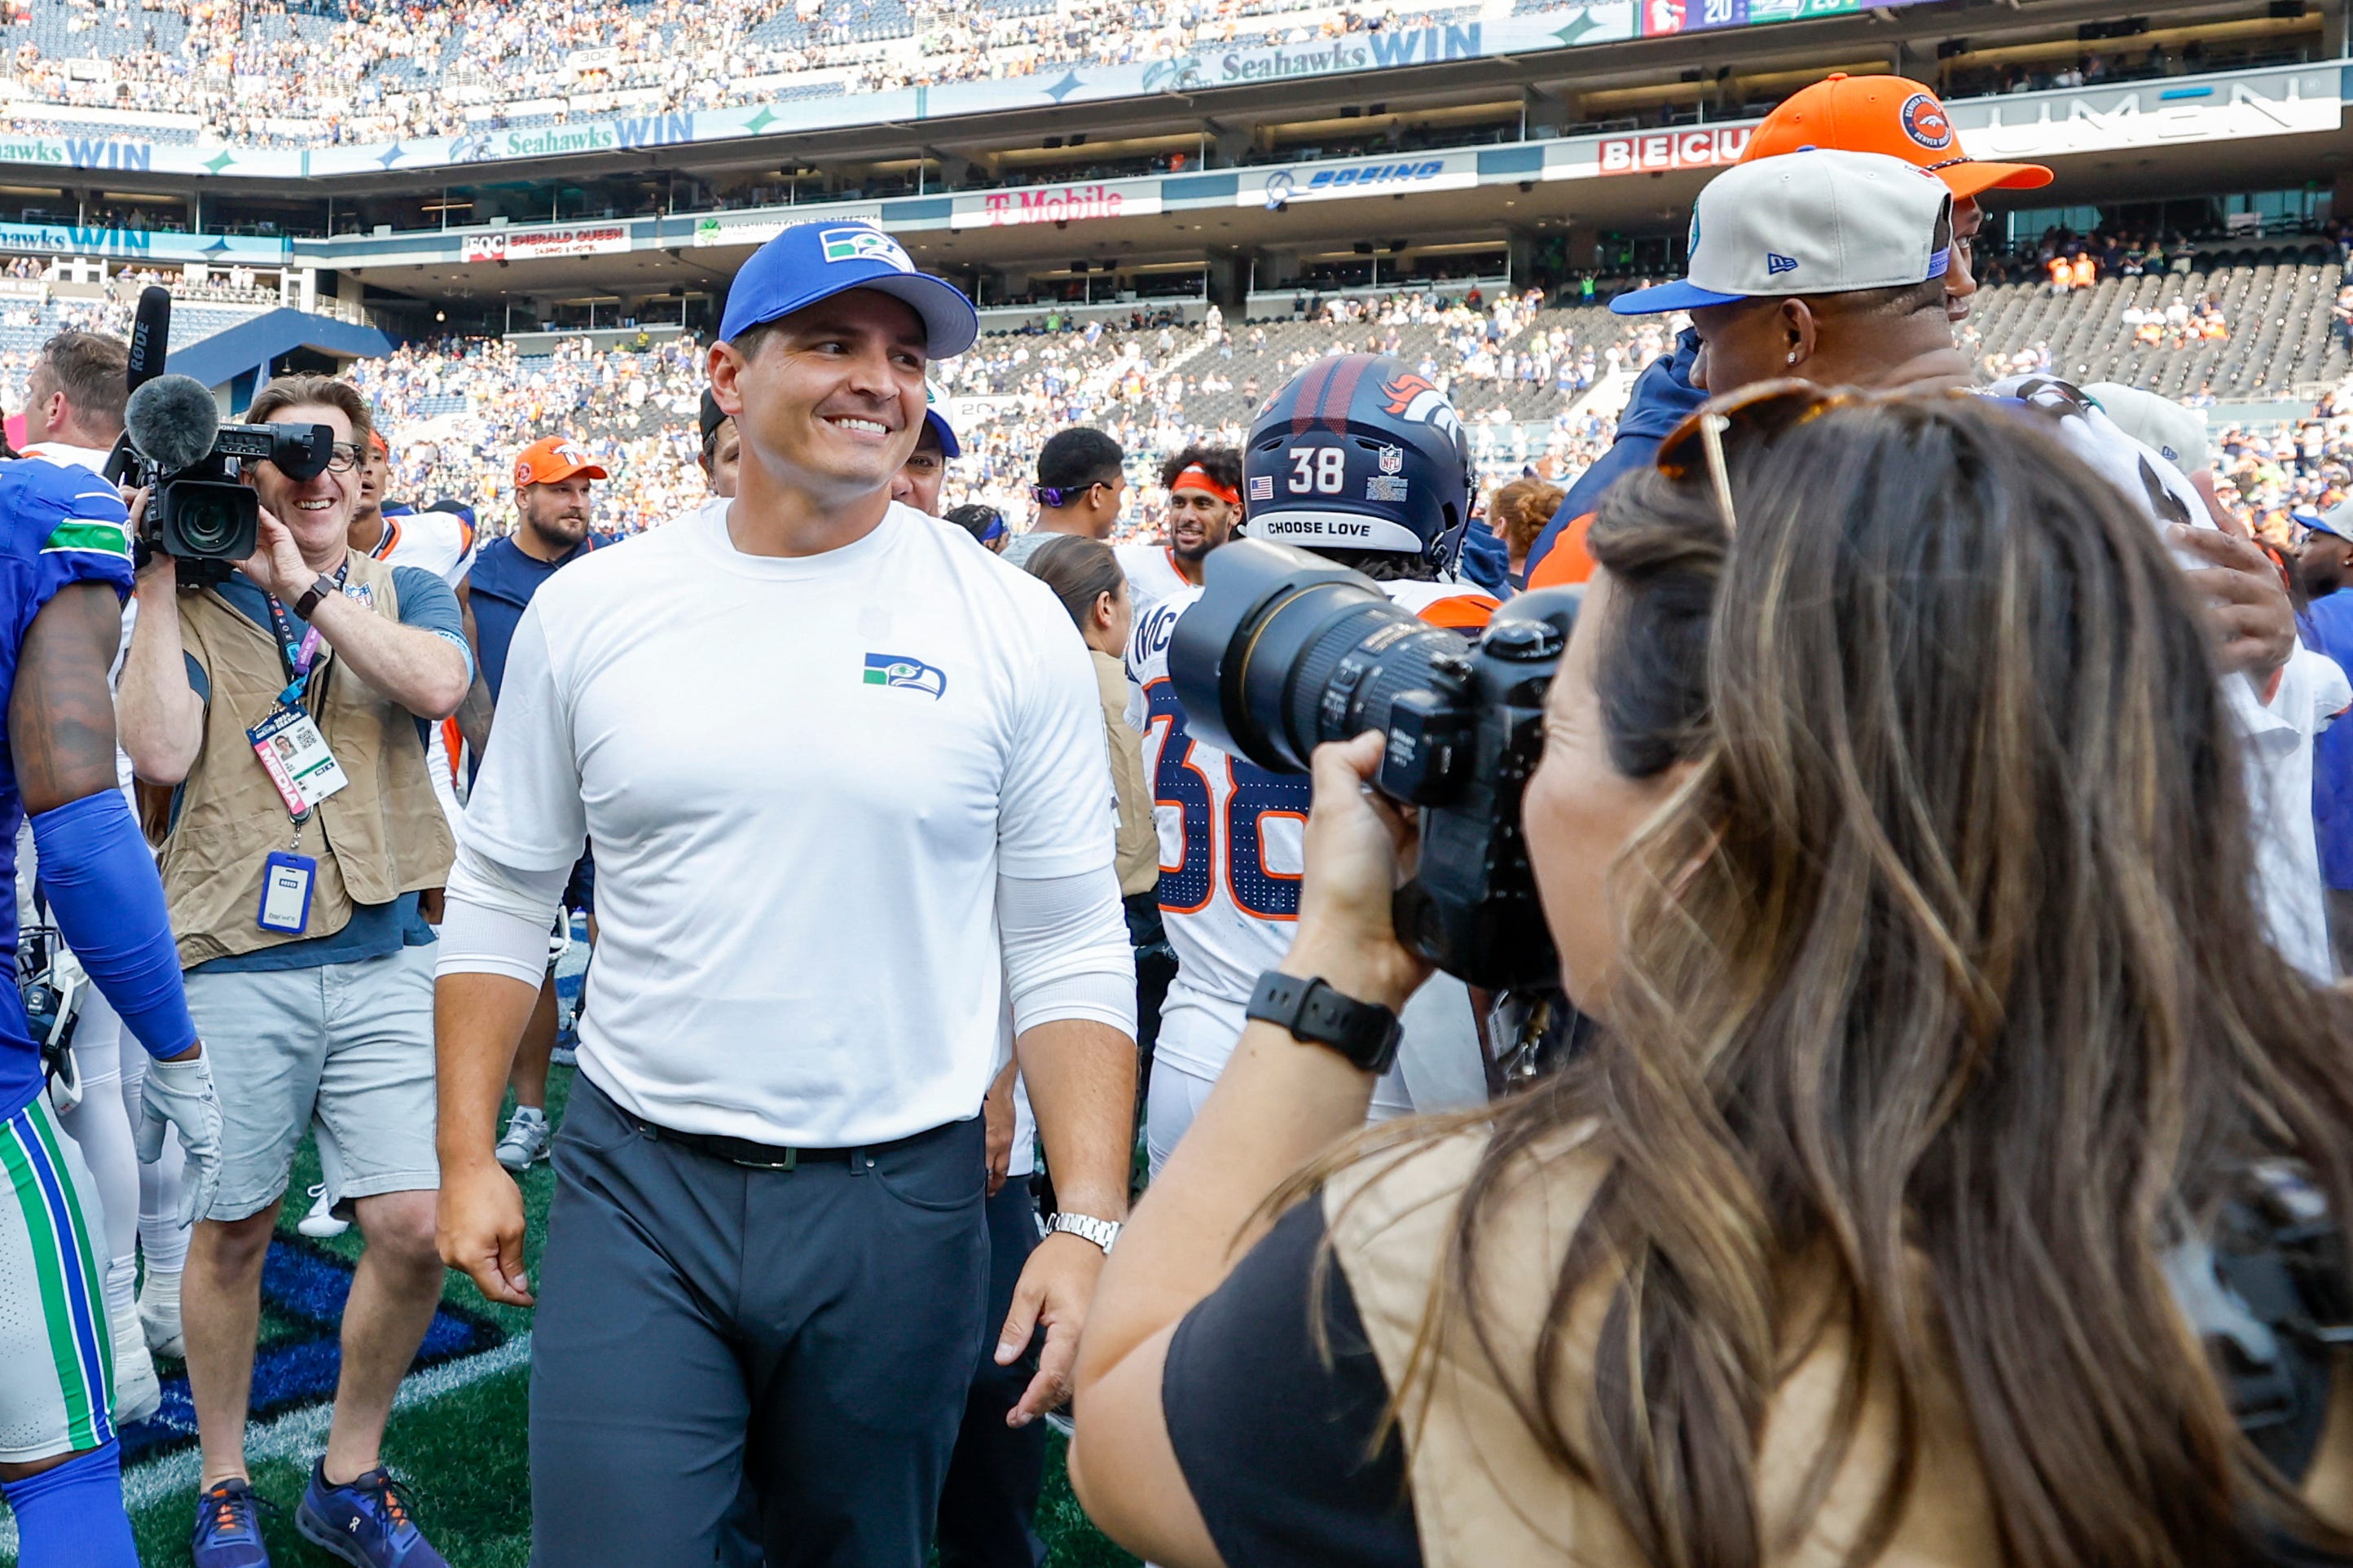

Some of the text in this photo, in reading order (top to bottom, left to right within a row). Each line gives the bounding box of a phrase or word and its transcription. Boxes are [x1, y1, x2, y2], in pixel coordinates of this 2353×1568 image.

[1222, 22, 1482, 81] Seahawks WIN
[508, 112, 694, 156] Seahawks WIN
[1602, 129, 1752, 170] BECU
[65, 139, 151, 171] WIN
[1308, 160, 1445, 189] BOEING
[67, 226, 150, 258] WIN
[468, 235, 504, 258] EQC
[510, 227, 624, 247] EMERALD QUEEN
[130, 321, 149, 371] RØDE
[1288, 446, 1345, 494] 38
[1383, 458, 1400, 470] NFL
[1268, 521, 1371, 538] CHOOSE LOVE
[275, 711, 302, 730] SEASON
[260, 746, 301, 809] MEDIA
